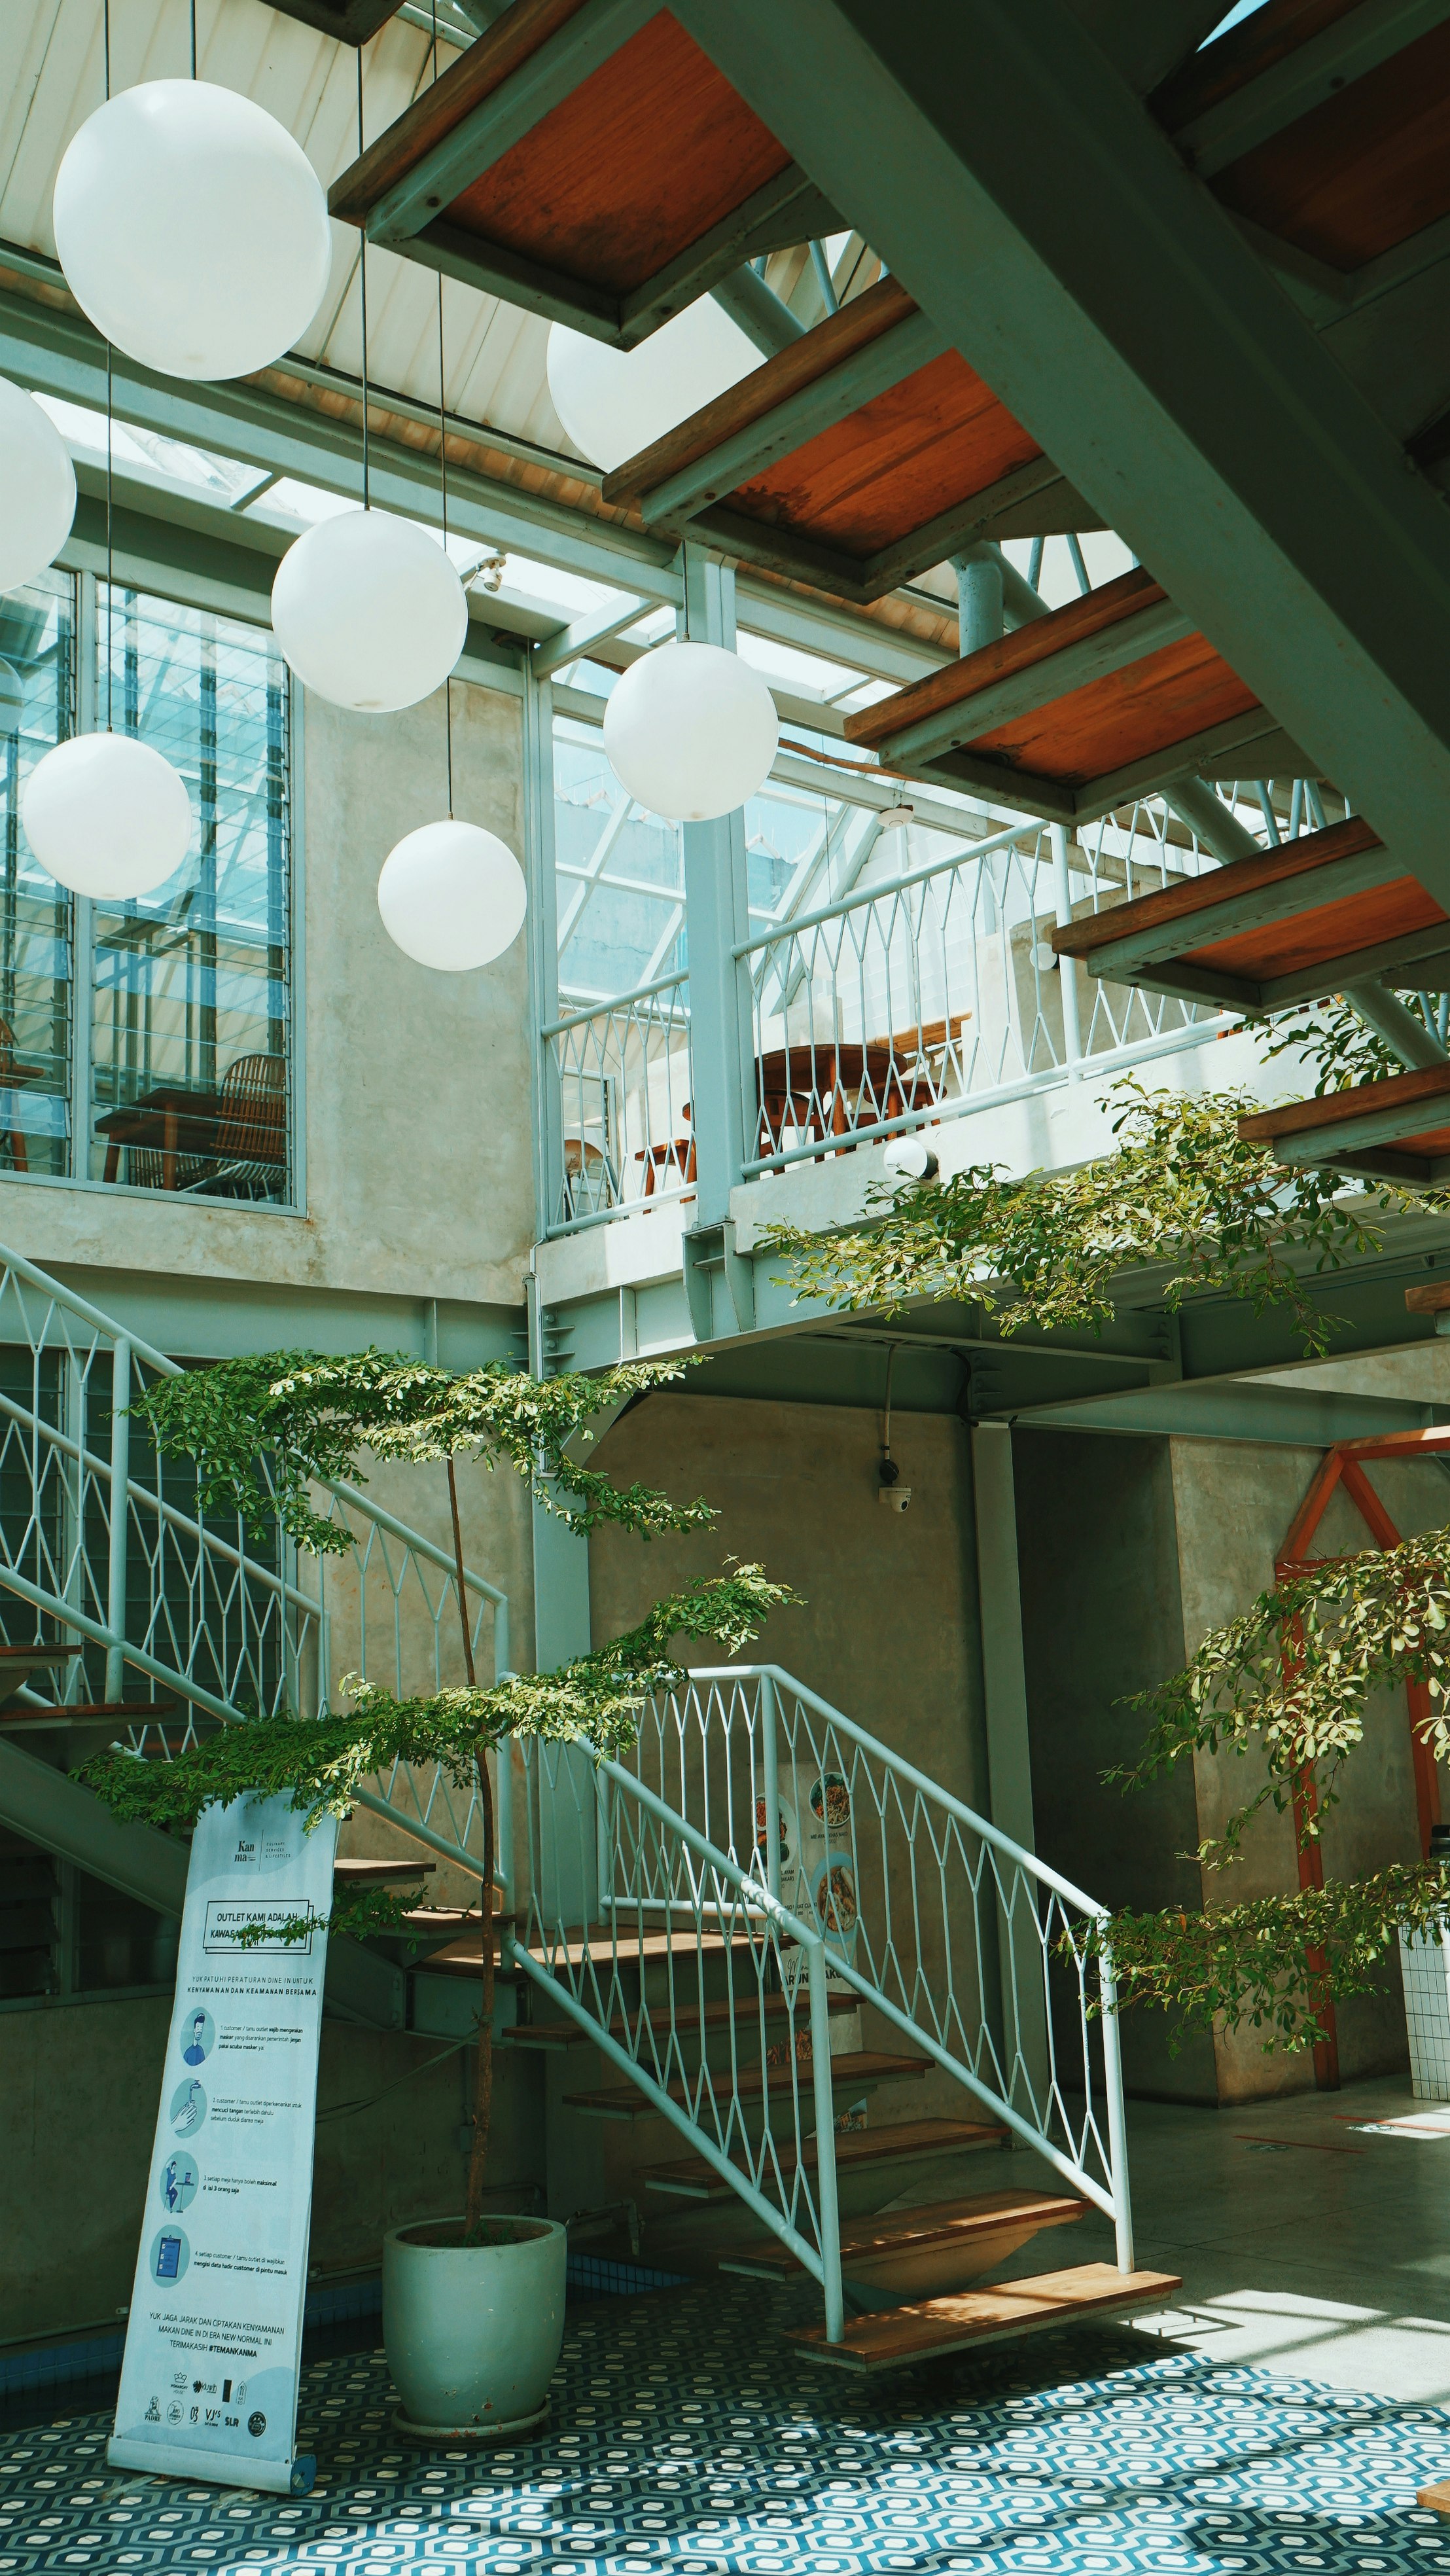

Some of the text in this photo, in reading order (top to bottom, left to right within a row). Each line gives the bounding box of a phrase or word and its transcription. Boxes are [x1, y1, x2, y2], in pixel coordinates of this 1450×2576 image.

[238, 1840, 255, 1852] Kan
[217, 1912, 298, 1922] OUTLET KAMI ADALAH
[260, 2267, 274, 2276] pintu
[149, 2312, 285, 2335] YUK JAGA JARAK DAN CIPTAKAN KENYAMANAN
[158, 2325, 181, 2335] MAKAN
[181, 2327, 194, 2336] DINE
[202, 2330, 209, 2338] DI
[209, 2331, 221, 2339] ERA
[221, 2333, 237, 2342] NEW
[237, 2334, 263, 2345] NORMAL
[169, 2339, 258, 2357] TERIMAKASIH #TEMANKANMA
[145, 2414, 161, 2422] PADRE
[224, 2416, 239, 2427] SLR
